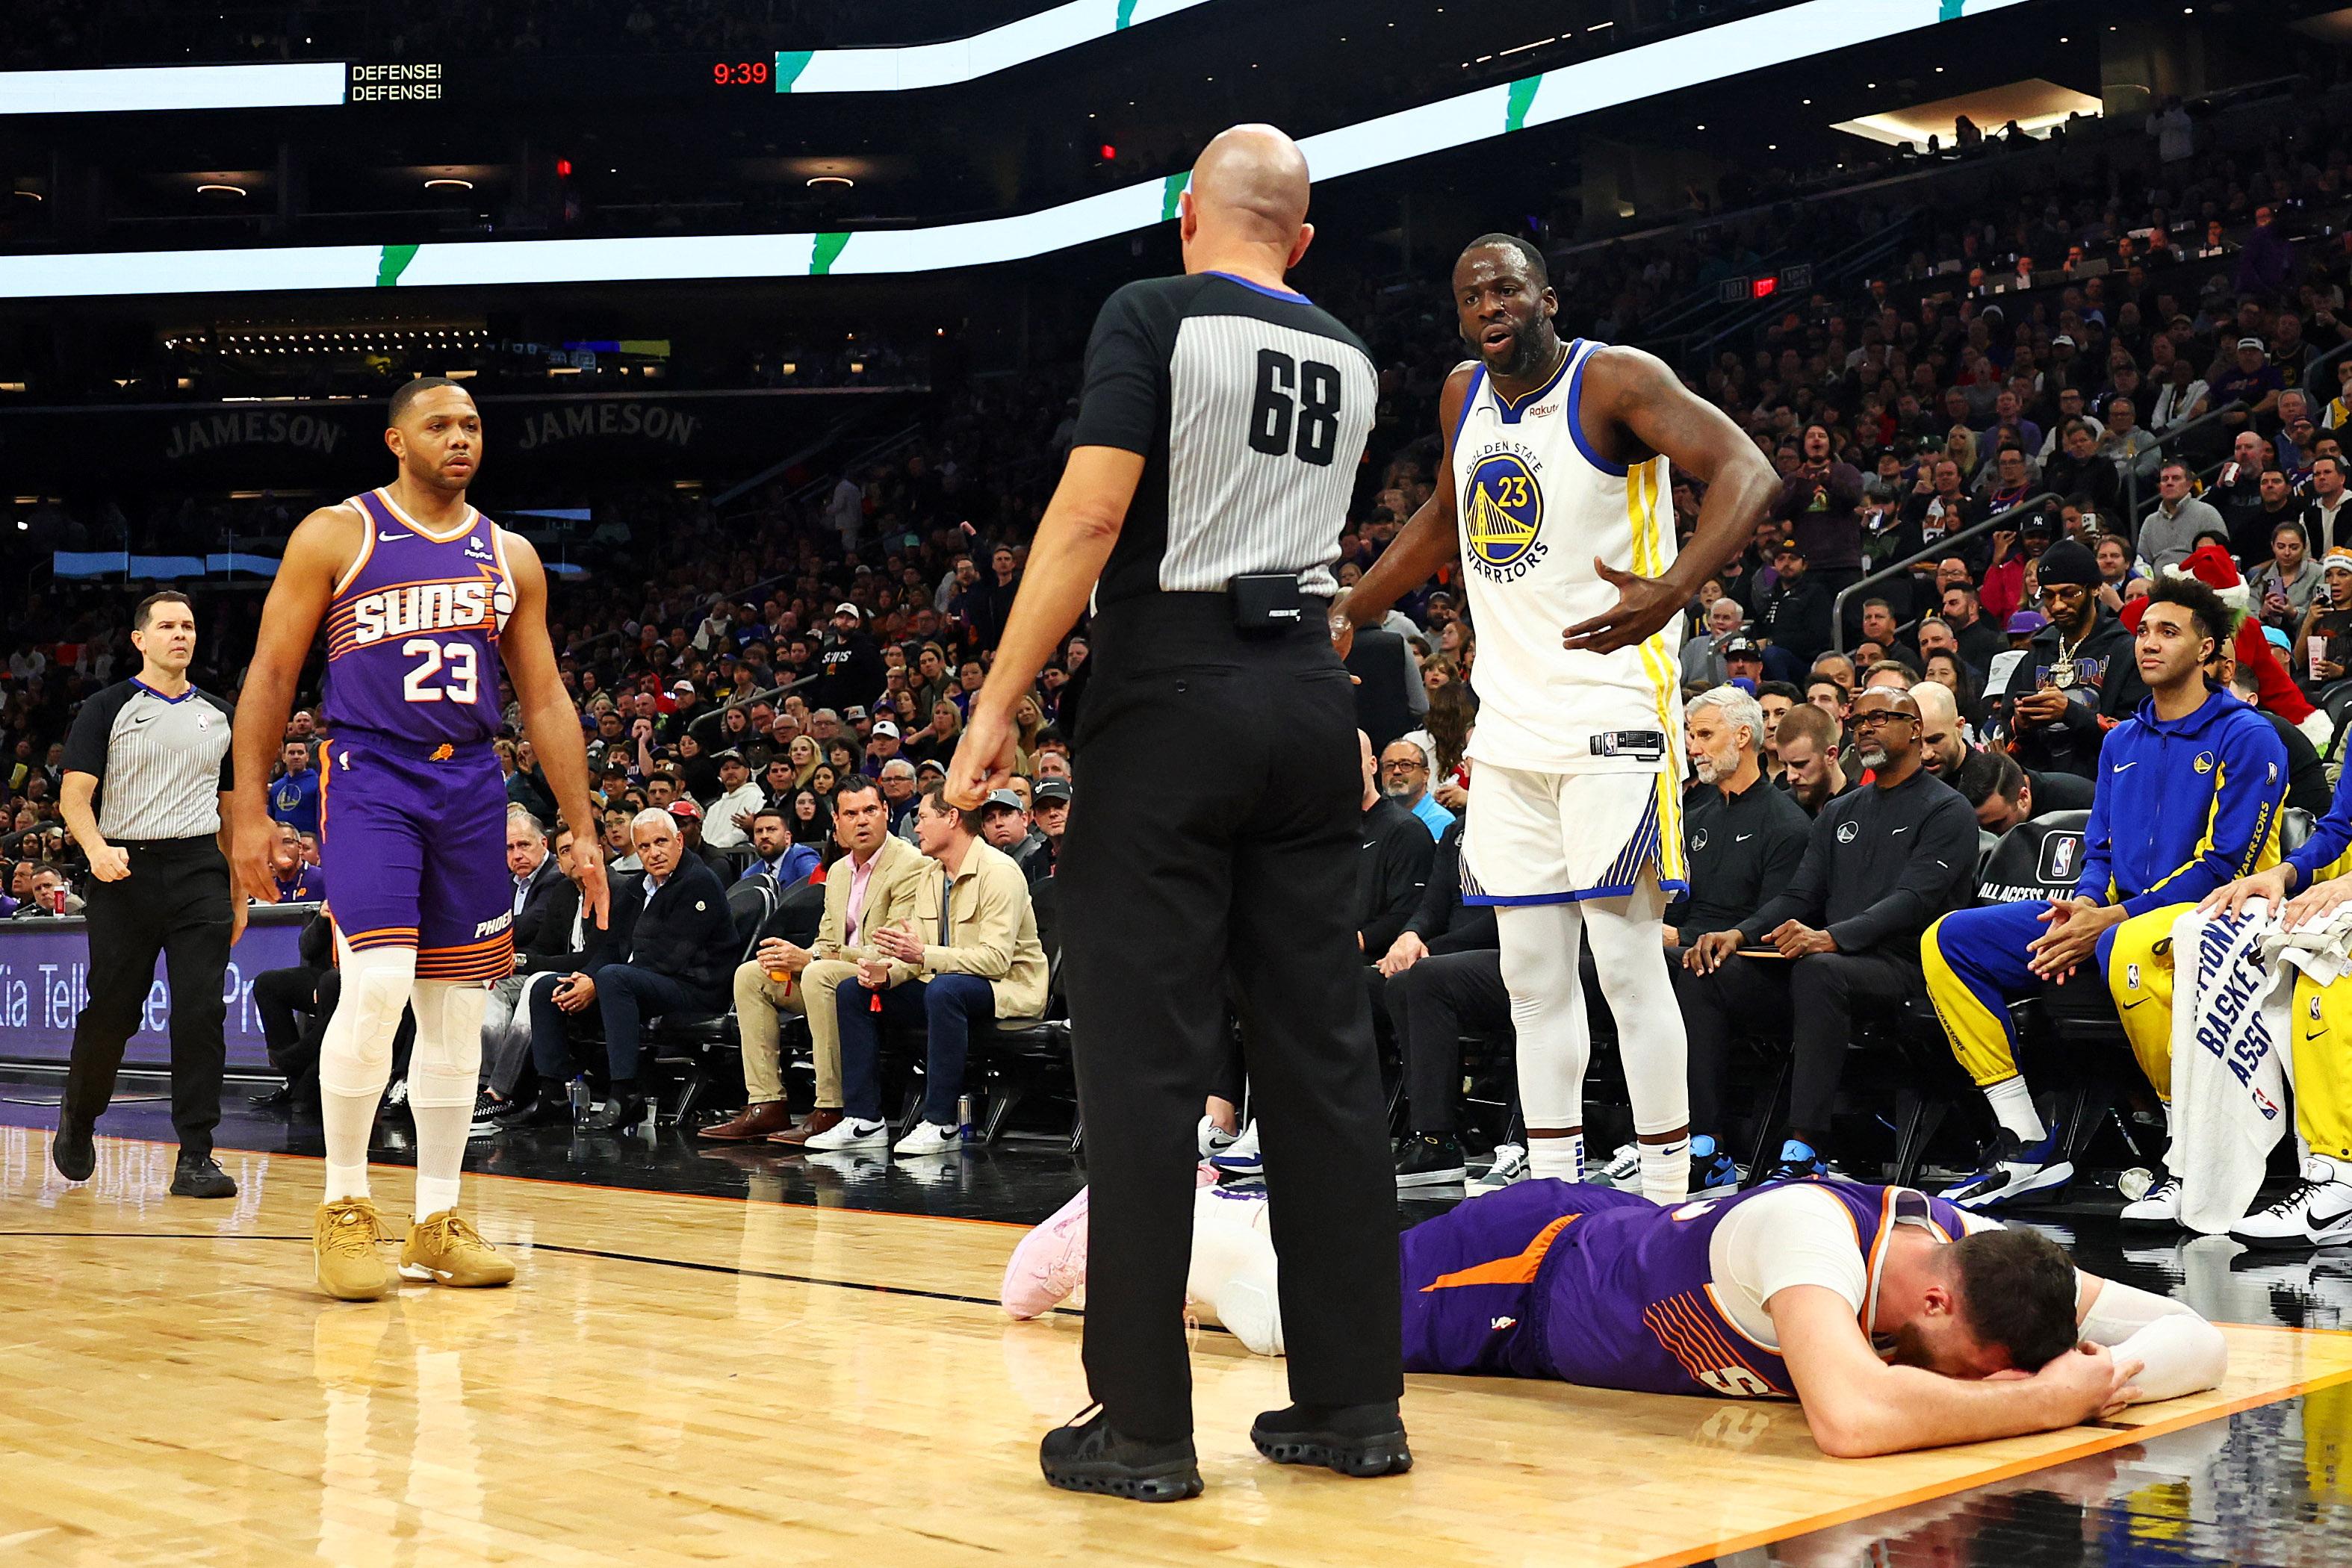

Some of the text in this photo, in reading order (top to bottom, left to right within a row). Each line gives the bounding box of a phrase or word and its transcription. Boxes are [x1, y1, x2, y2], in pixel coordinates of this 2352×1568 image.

[353, 63, 441, 81] DEFENSE!
[714, 63, 768, 84] 9:39
[353, 84, 441, 101] DEFENSE!
[518, 403, 696, 449] JAMESON
[1248, 349, 1341, 467] 68
[1530, 404, 1559, 417] Rakut
[166, 411, 341, 458] JAMESON
[1466, 441, 1543, 475] GOLDEN STATE
[1498, 476, 1528, 507] 23
[464, 549, 493, 561] PayPal
[1467, 541, 1548, 584] WARRIORS
[402, 639, 479, 704] 23
[2232, 800, 2269, 881] WARRIORS
[1977, 882, 2000, 900] ALL
[1998, 886, 2044, 903] ACCESS
[0, 964, 28, 1028] ia
[2196, 933, 2267, 1059] BASKET
